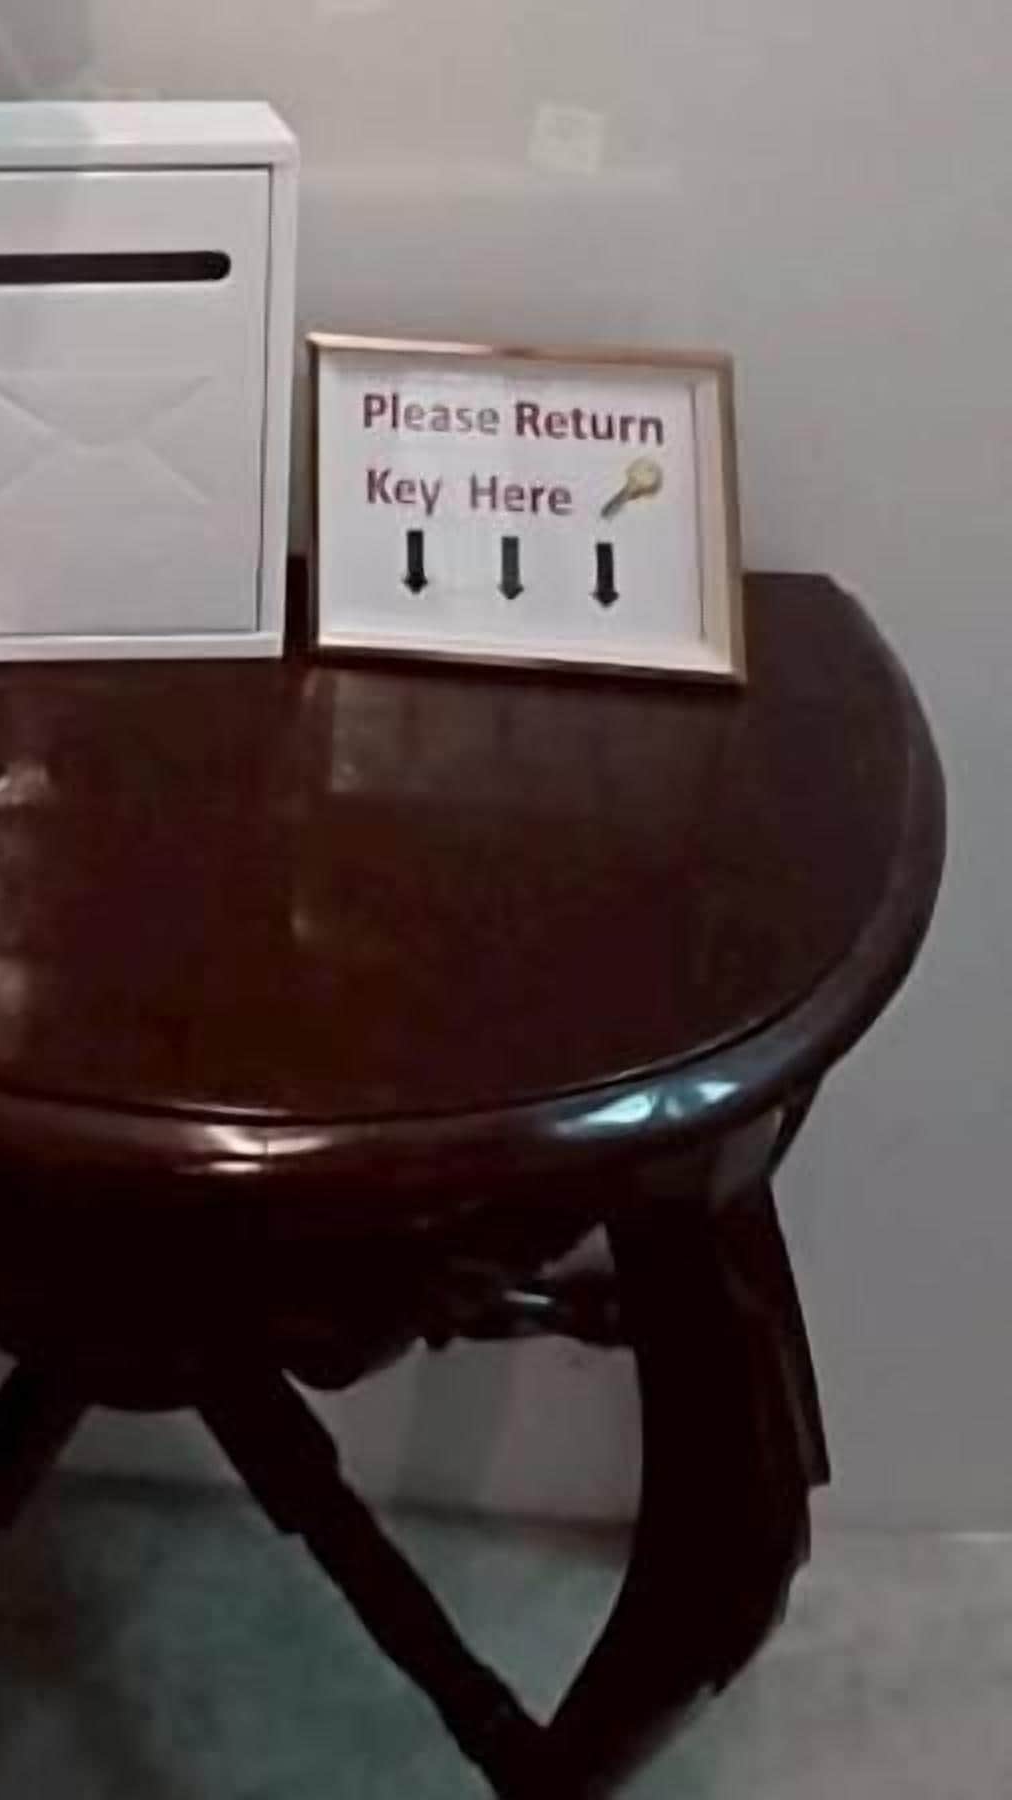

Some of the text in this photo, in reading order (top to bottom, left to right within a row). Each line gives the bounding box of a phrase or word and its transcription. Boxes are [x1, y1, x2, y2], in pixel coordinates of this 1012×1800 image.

[363, 392, 665, 445] Please Return
[365, 468, 574, 517] Key Here
